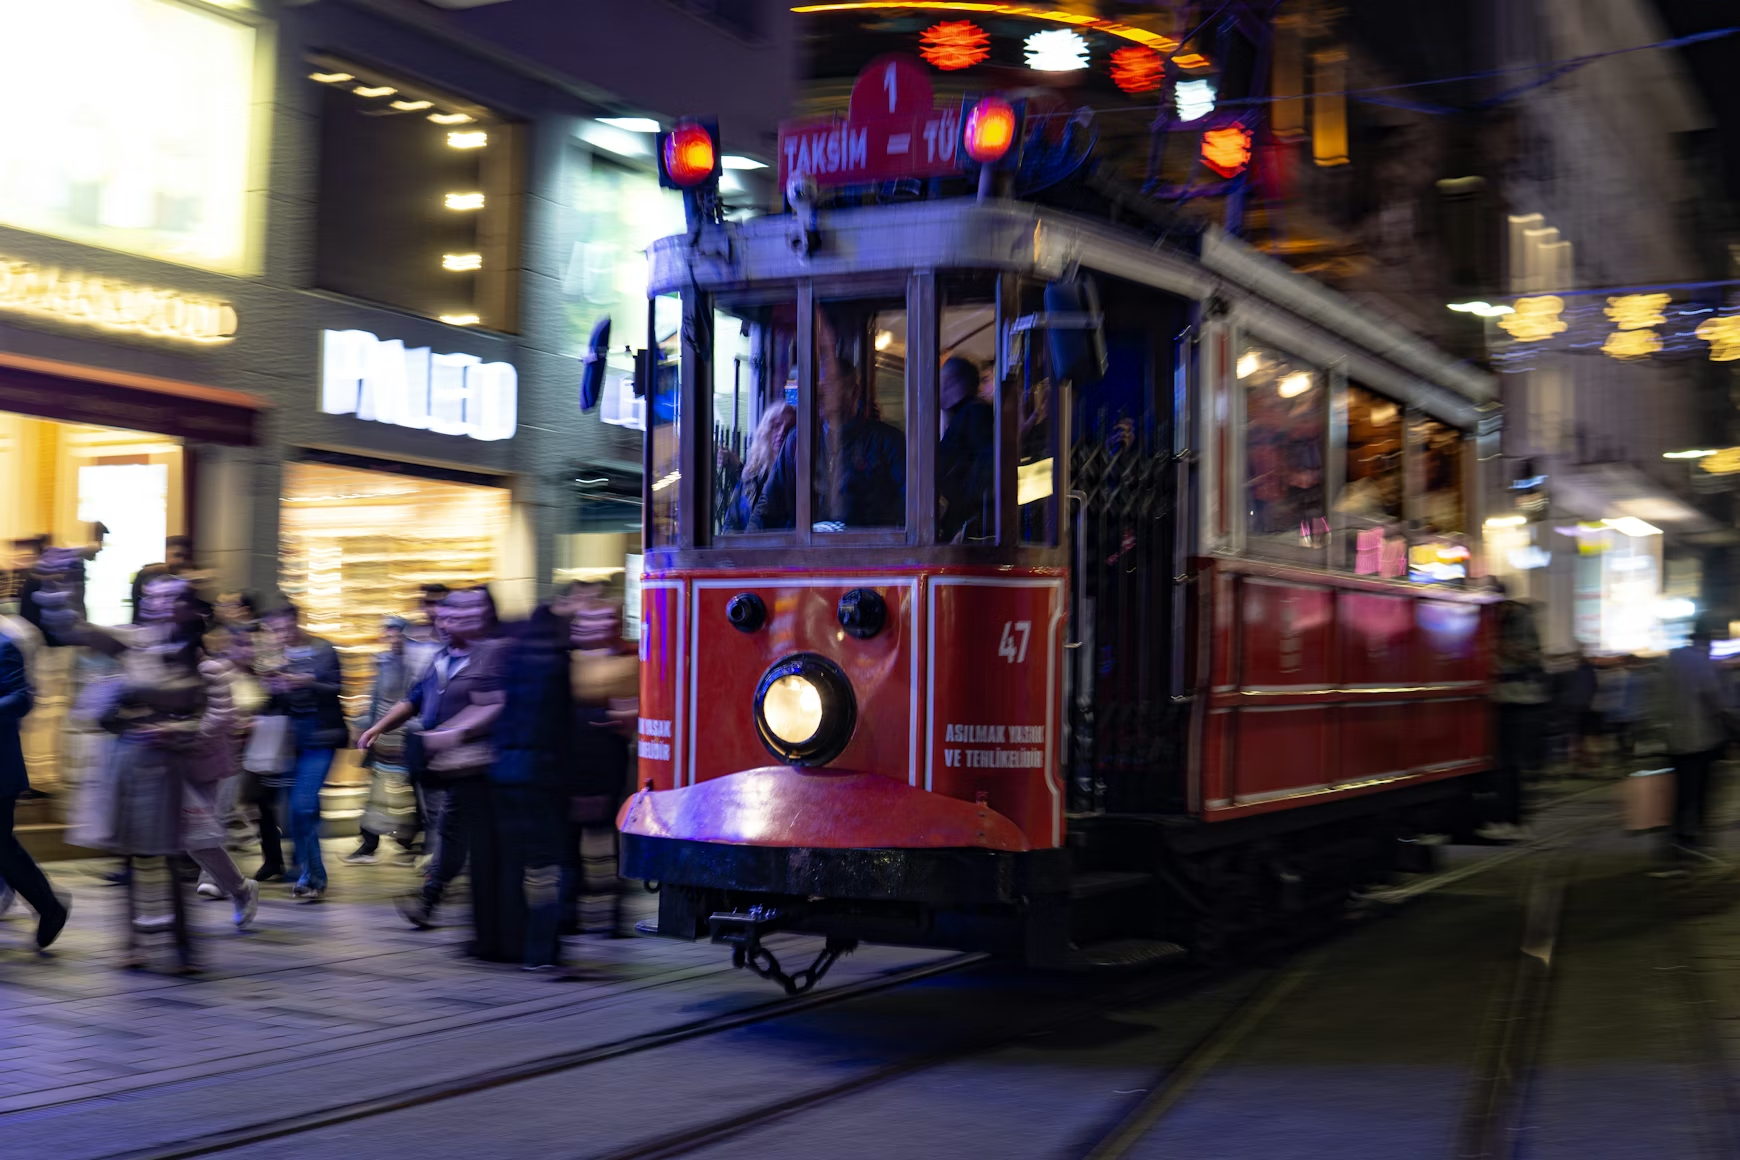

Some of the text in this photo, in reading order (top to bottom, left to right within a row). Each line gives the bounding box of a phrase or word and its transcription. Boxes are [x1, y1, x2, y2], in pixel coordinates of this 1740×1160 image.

[884, 61, 897, 113] 1
[784, 120, 868, 176] TAKSİM
[923, 108, 960, 163] TÜ
[998, 620, 1031, 664] 47
[945, 724, 1006, 744] ASILMAK
[944, 749, 962, 767] VE
